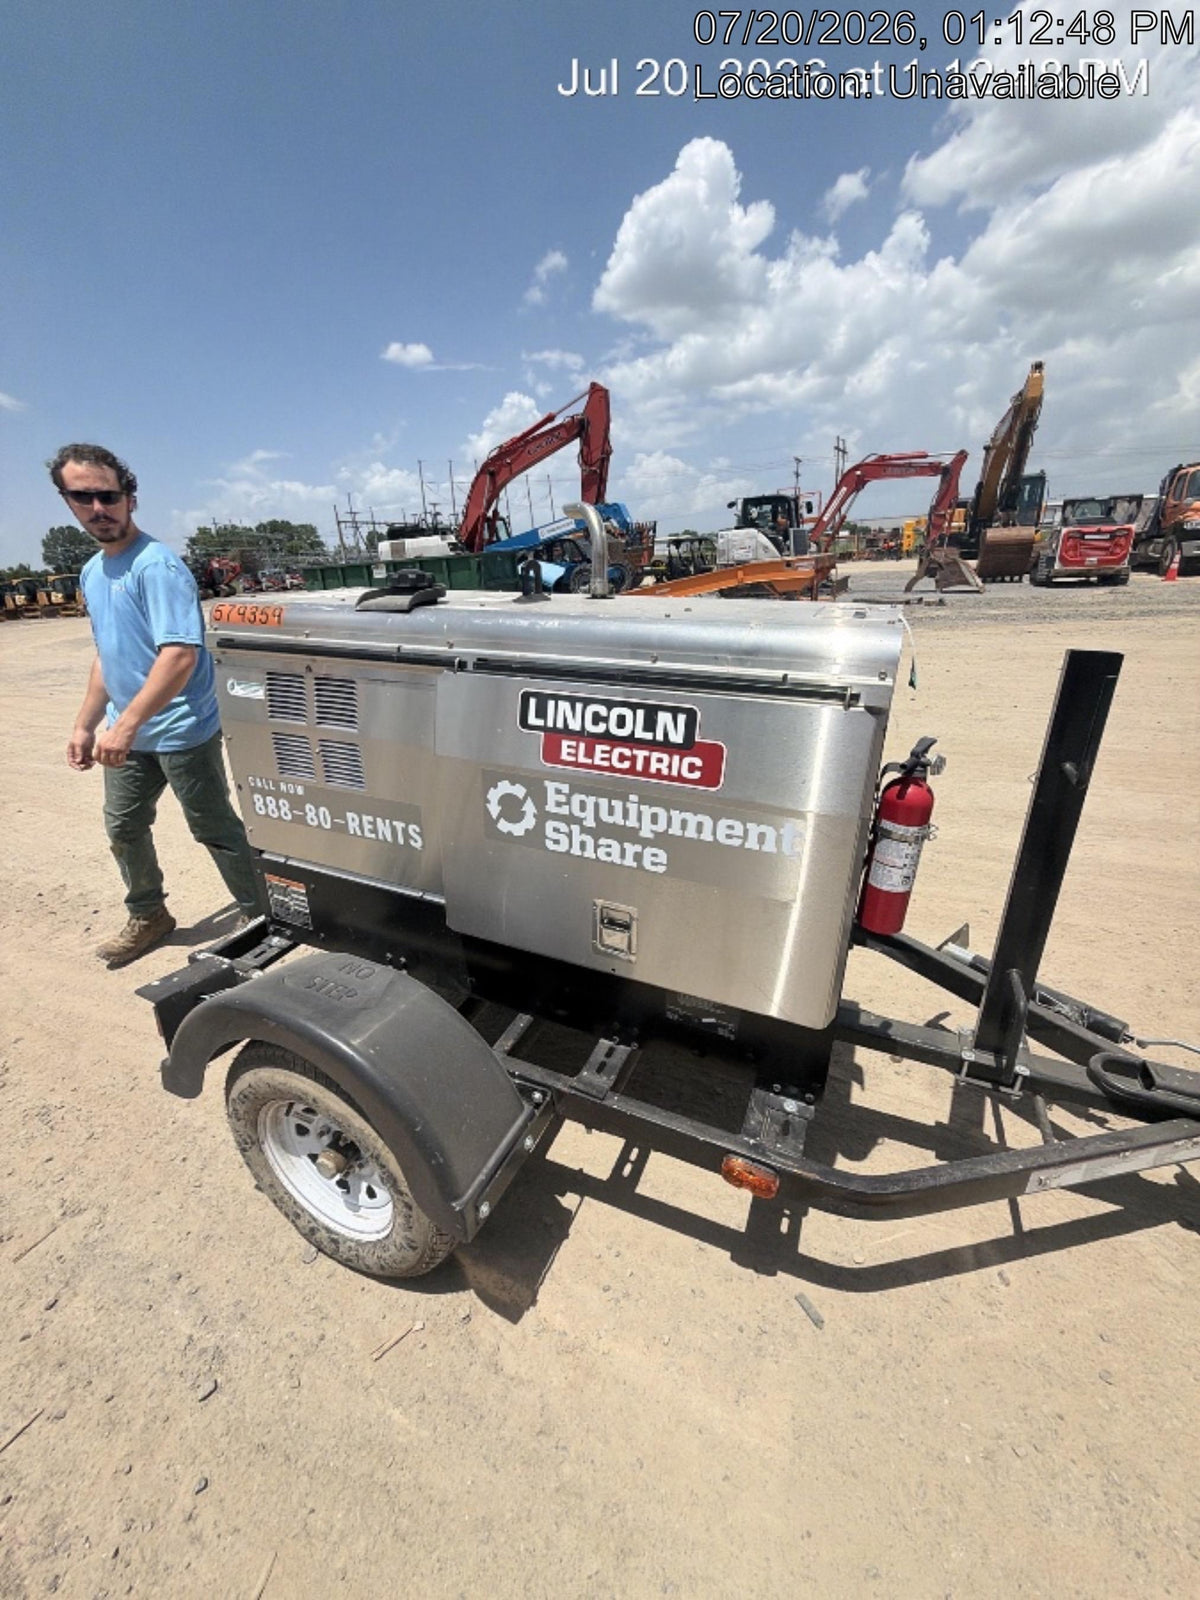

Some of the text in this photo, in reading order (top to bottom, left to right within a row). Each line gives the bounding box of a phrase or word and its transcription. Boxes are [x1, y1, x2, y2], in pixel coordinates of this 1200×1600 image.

[527, 696, 687, 744] LINCOLN
[560, 739, 703, 780] ELECTRIC
[247, 776, 305, 795] CALL NOW
[253, 793, 424, 850] 888-80-RENTS
[544, 780, 804, 858] Equipment
[544, 819, 669, 875] Share
[304, 975, 358, 1002] STEP
[339, 962, 376, 980] NO
